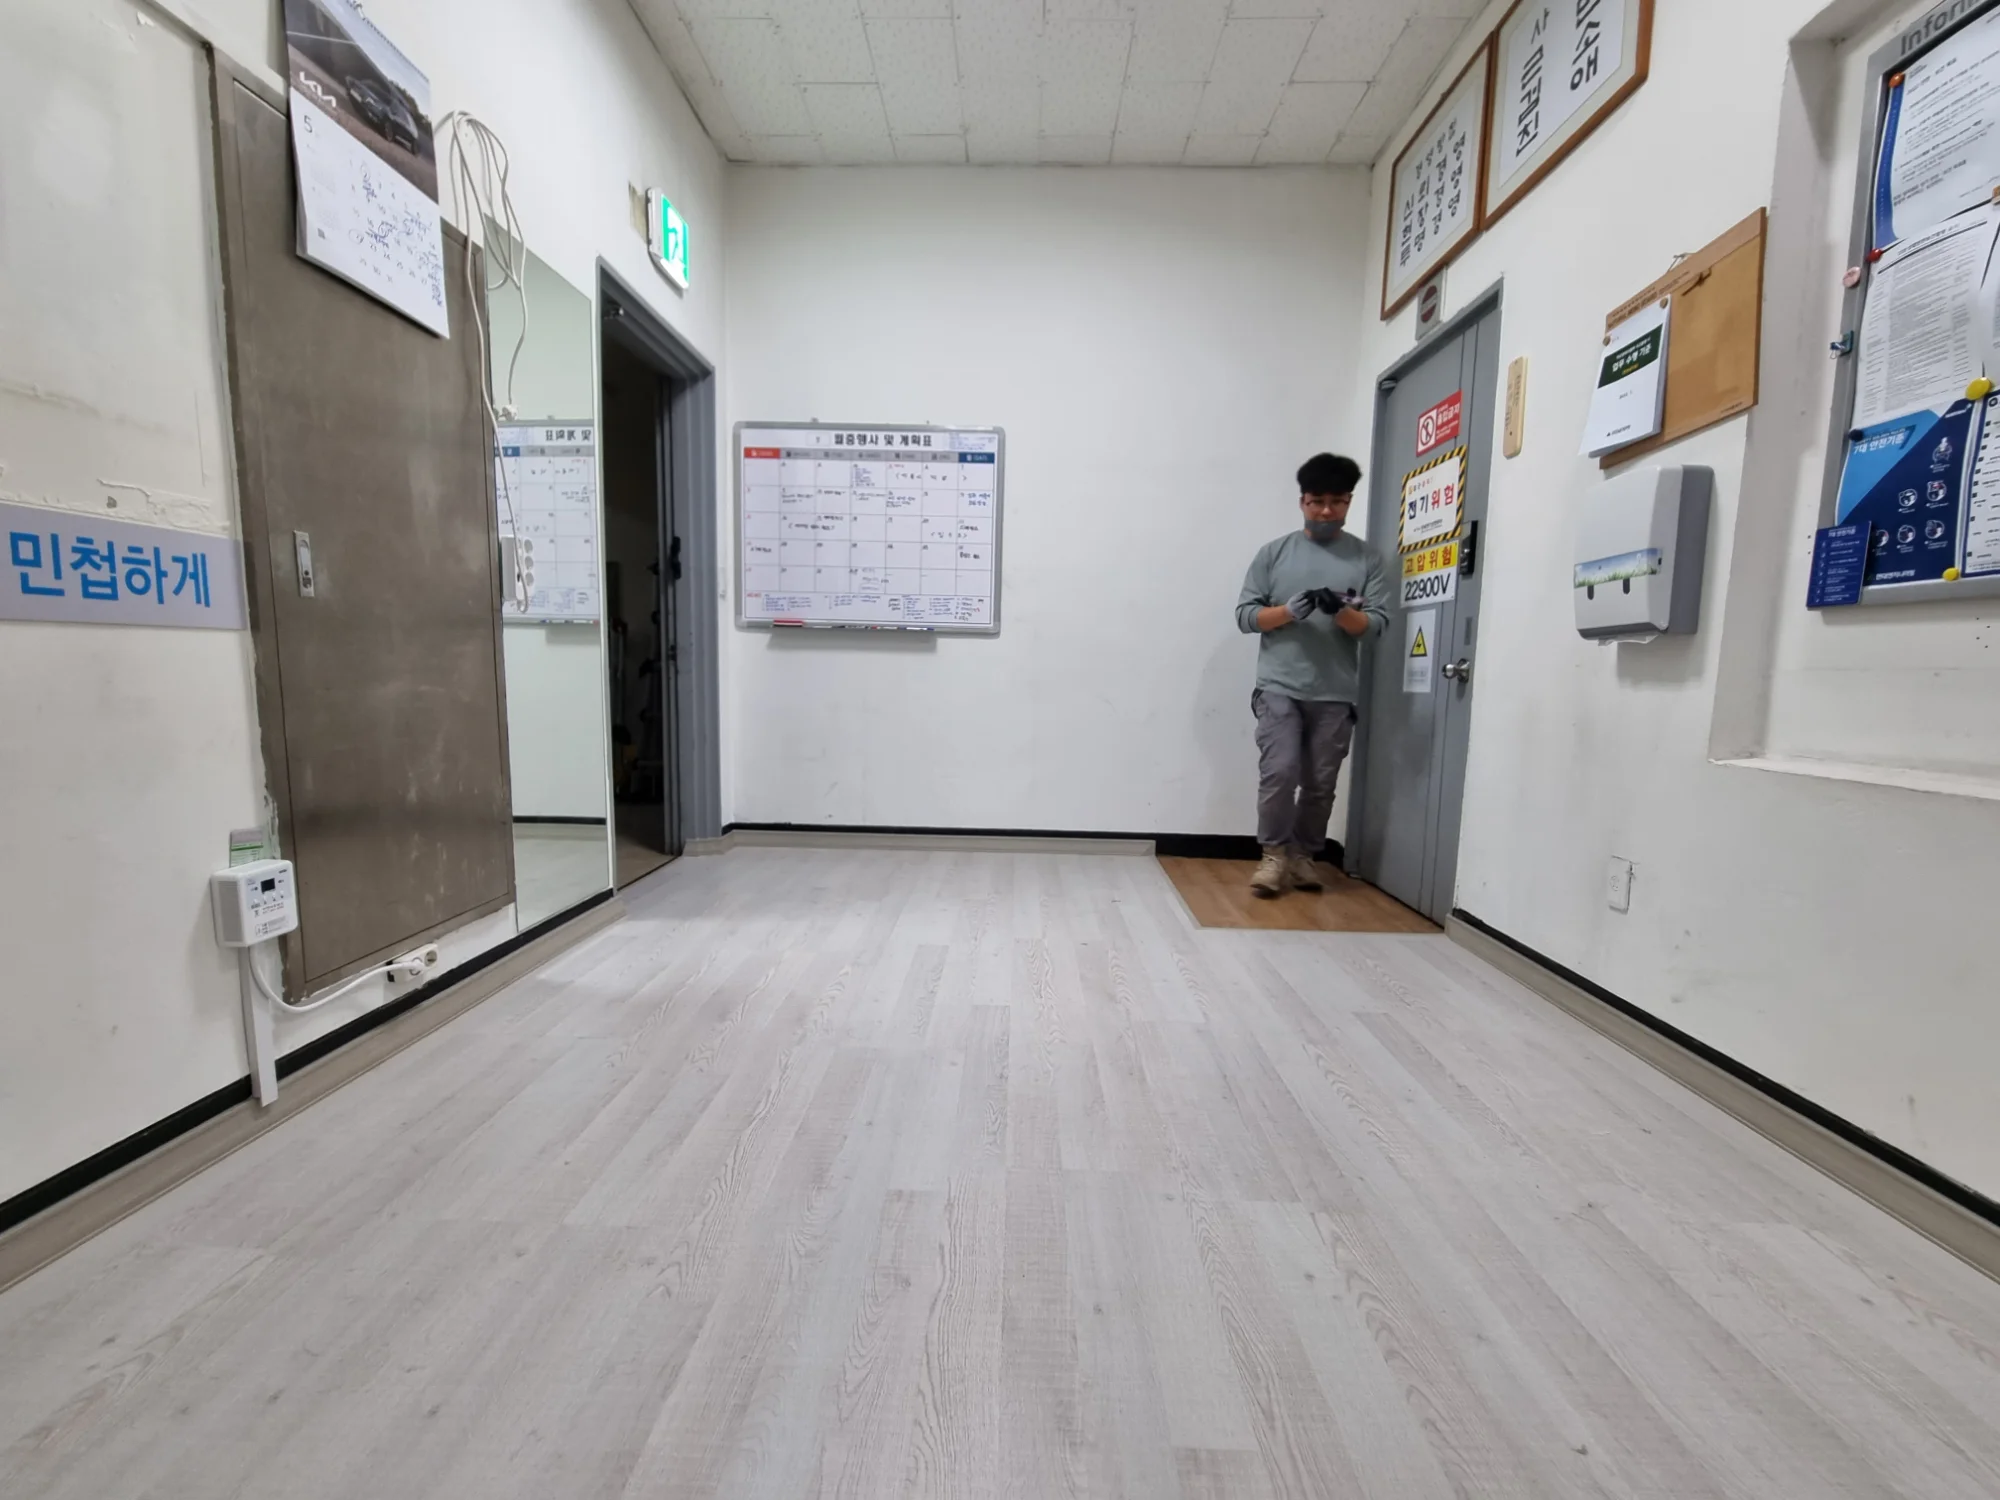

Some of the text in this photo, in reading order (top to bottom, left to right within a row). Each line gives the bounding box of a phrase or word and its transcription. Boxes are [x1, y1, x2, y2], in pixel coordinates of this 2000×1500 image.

[834, 433, 932, 447] 월중행사 및 계획표
[9, 531, 212, 608] 민첩하게
[1404, 544, 1454, 574] 고압위험
[1404, 572, 1451, 602] 22900V
